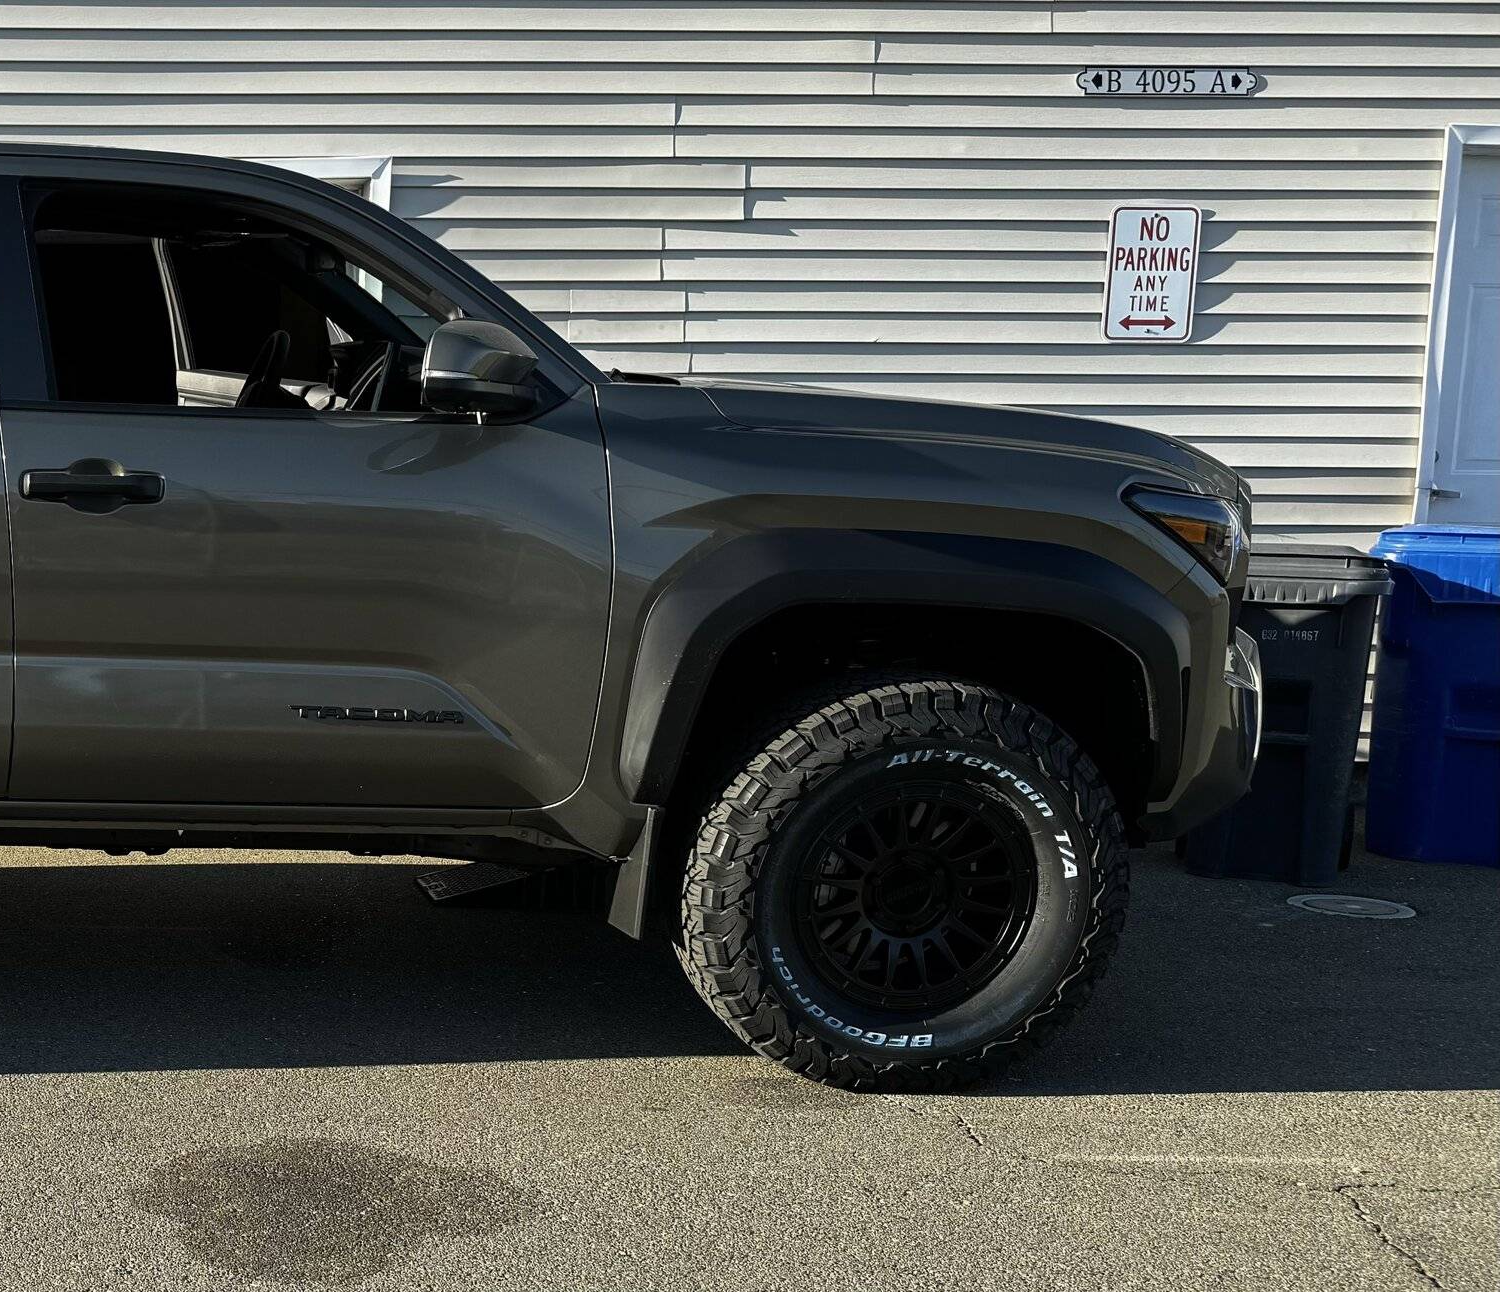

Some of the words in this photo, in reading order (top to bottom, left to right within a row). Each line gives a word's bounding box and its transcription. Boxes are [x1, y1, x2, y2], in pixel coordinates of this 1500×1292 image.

[1106, 69, 1122, 93] B
[1136, 69, 1196, 93] 4095
[1210, 69, 1227, 93] A
[1139, 216, 1170, 242] NO
[1114, 247, 1190, 272] PARKING
[1133, 275, 1168, 292] ANY
[1129, 295, 1169, 312] TIME
[288, 704, 465, 724] TACOMA
[886, 749, 1054, 819] All-Terrain
[1053, 828, 1079, 880] T/A
[770, 946, 934, 1049] BFGoodrich
